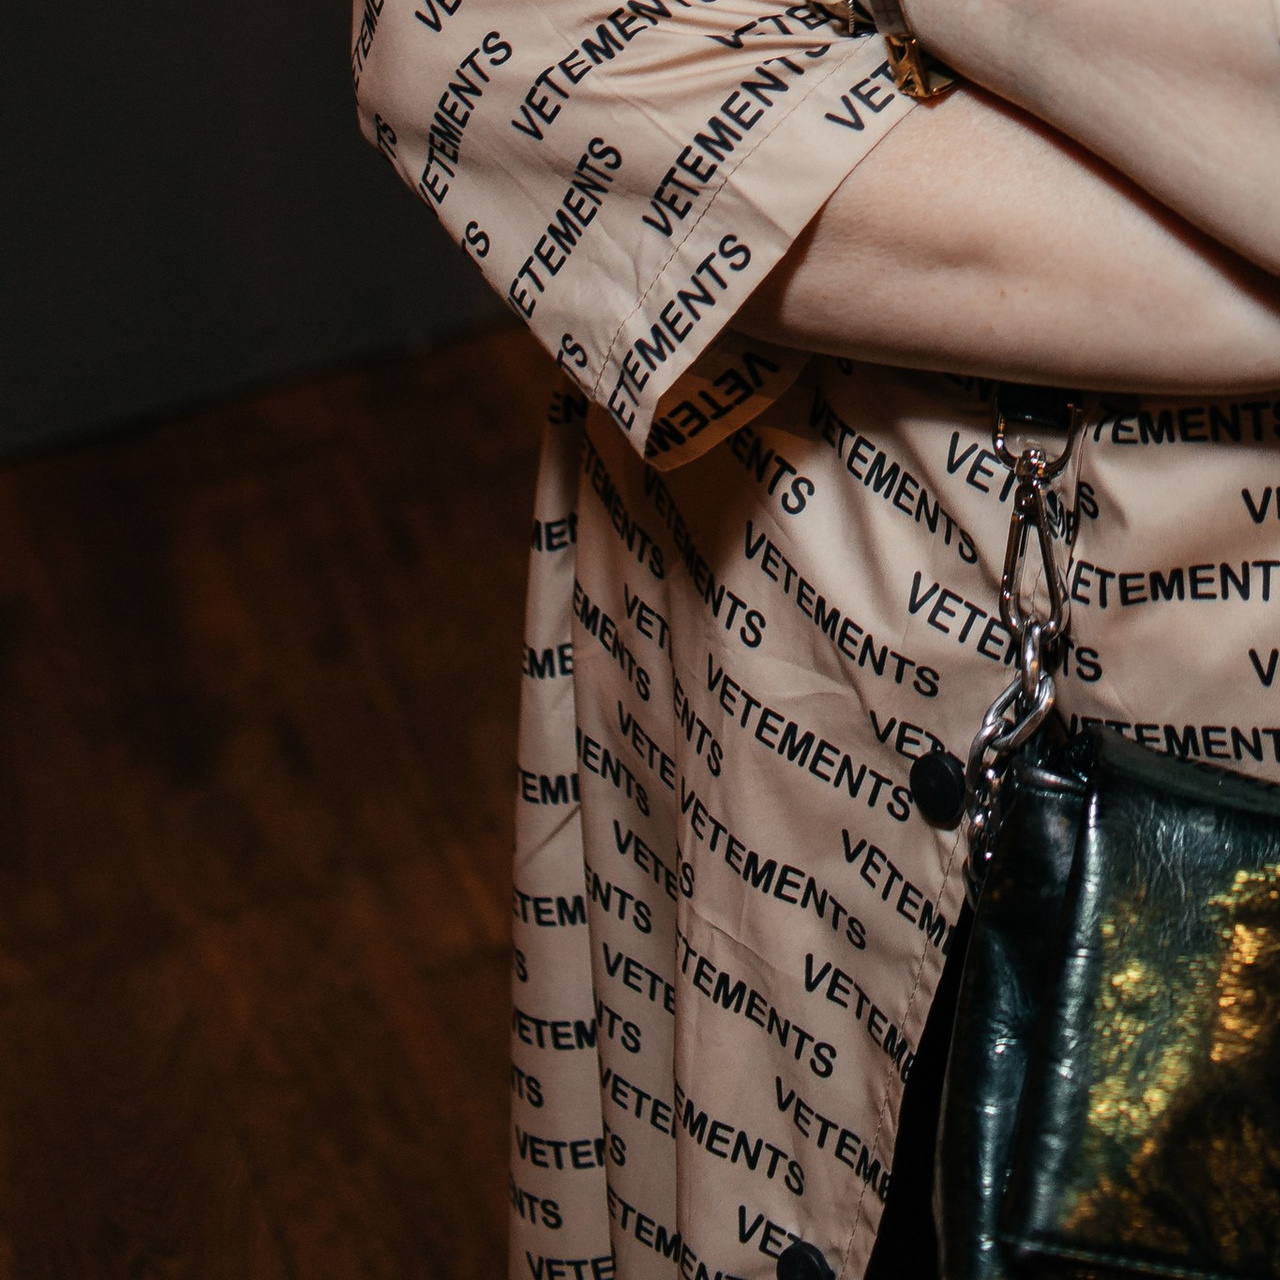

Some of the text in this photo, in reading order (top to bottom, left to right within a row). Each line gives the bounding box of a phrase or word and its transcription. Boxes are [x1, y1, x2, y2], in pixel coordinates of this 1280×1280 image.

[743, 520, 941, 699] VETEMENTS
[708, 653, 913, 822] VETEMENTS
[680, 776, 866, 950] VETEMENTS
